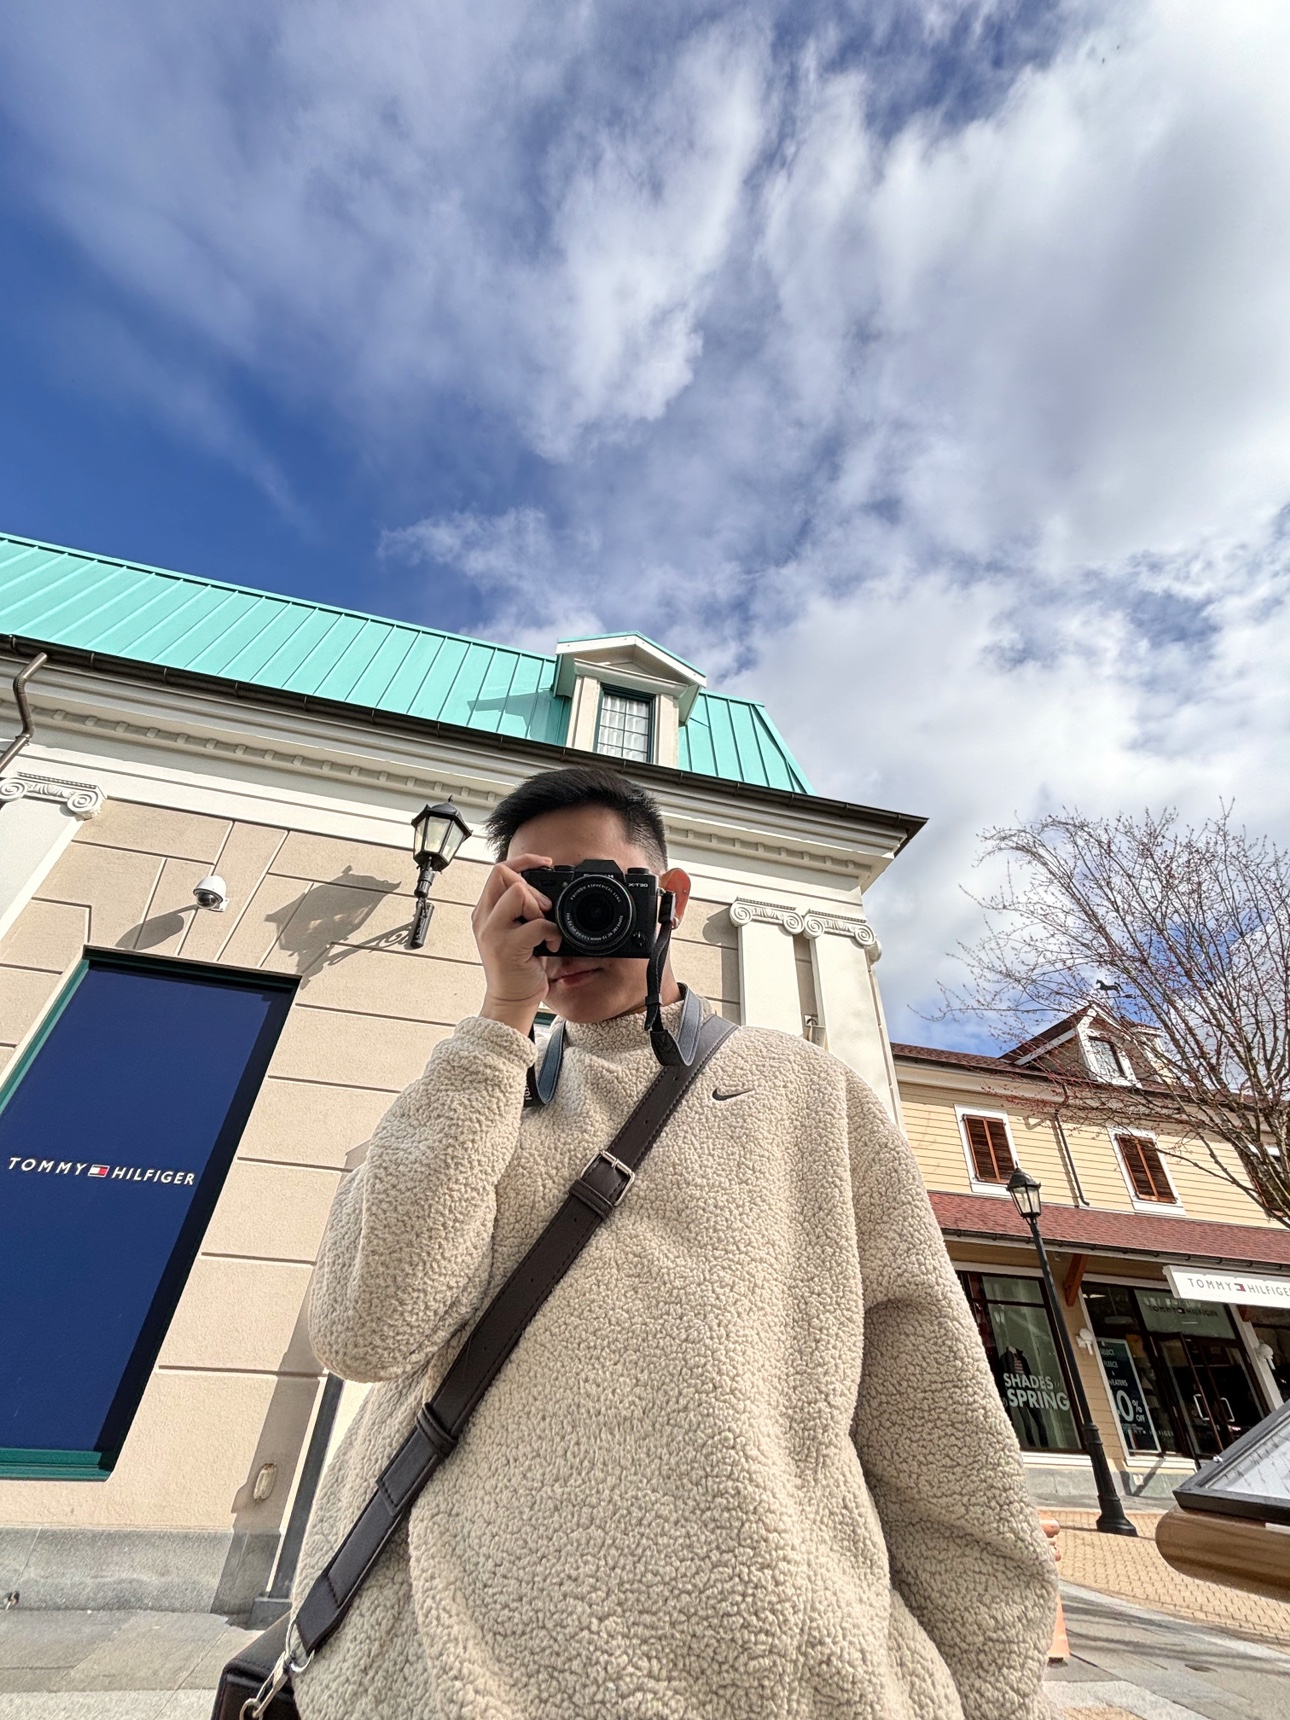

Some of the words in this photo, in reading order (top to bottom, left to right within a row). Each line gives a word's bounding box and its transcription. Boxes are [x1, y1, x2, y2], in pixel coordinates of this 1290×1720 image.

[8, 1157, 88, 1176] TOMMY
[111, 1166, 195, 1186] HILFIGER
[1187, 1277, 1233, 1292] TOMMY
[1246, 1283, 1290, 1297] HILFIGE
[1148, 1305, 1178, 1314] TOMMY
[1003, 1372, 1054, 1390] SHADES
[1007, 1388, 1070, 1411] SPRING
